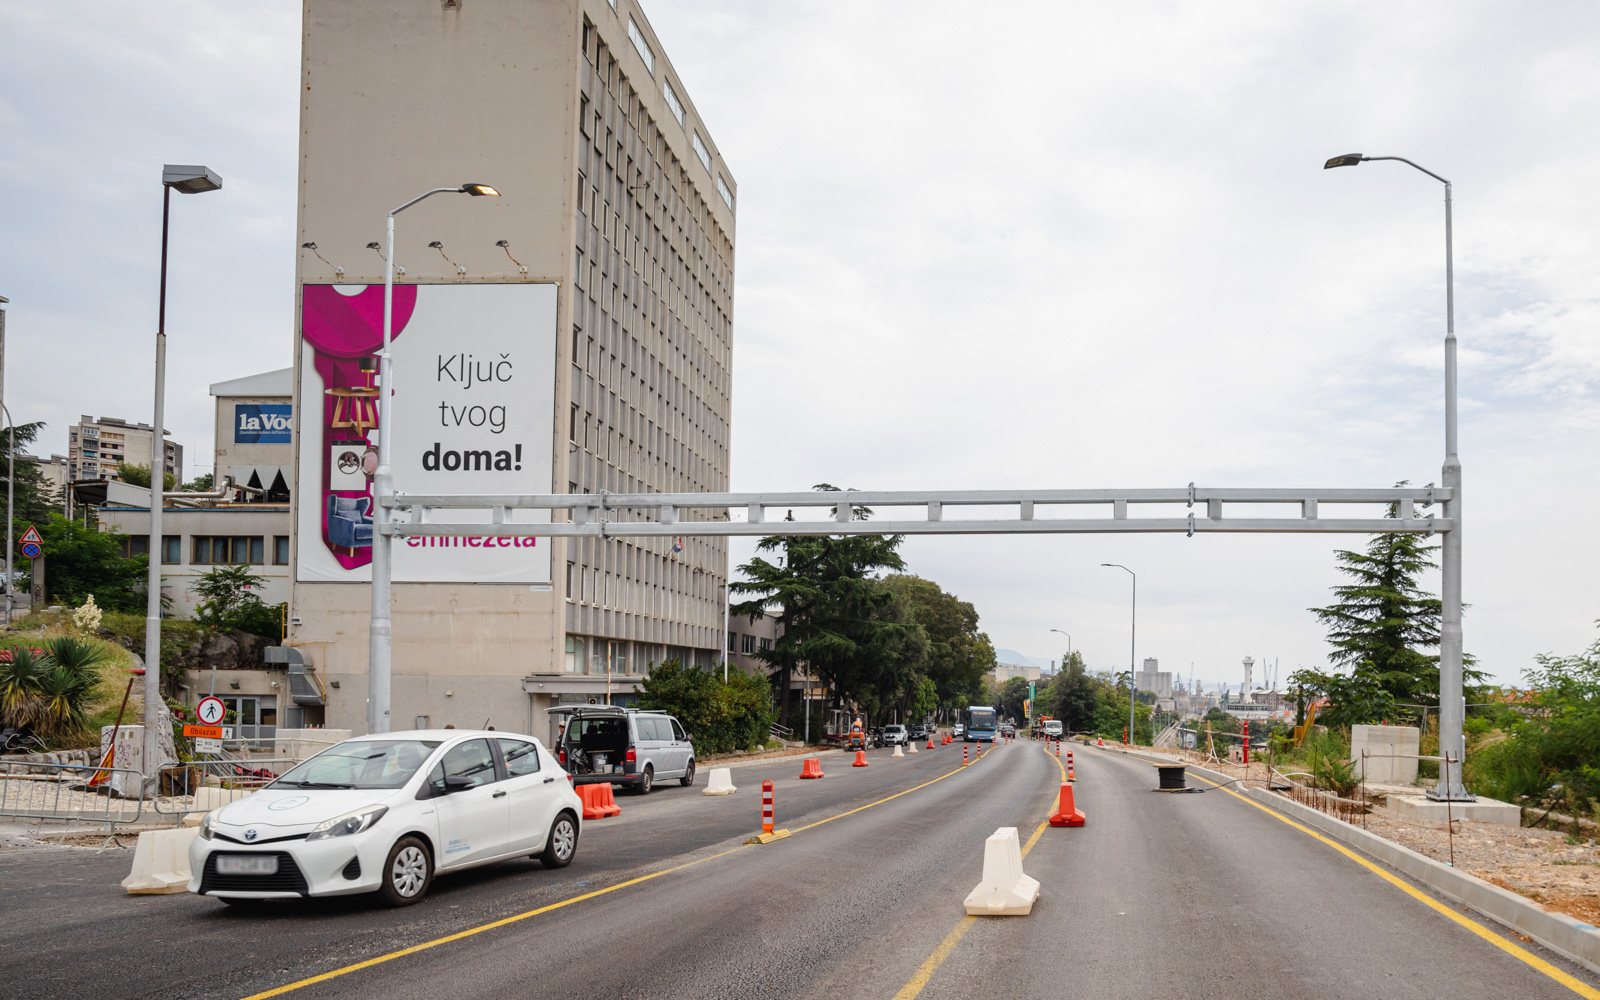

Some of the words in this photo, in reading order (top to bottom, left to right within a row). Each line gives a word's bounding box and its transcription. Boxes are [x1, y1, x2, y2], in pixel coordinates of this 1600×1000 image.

[437, 353, 513, 390] Ključ
[438, 400, 506, 434] tvog
[422, 442, 522, 471] doma!
[190, 727, 217, 736] Obilazak
